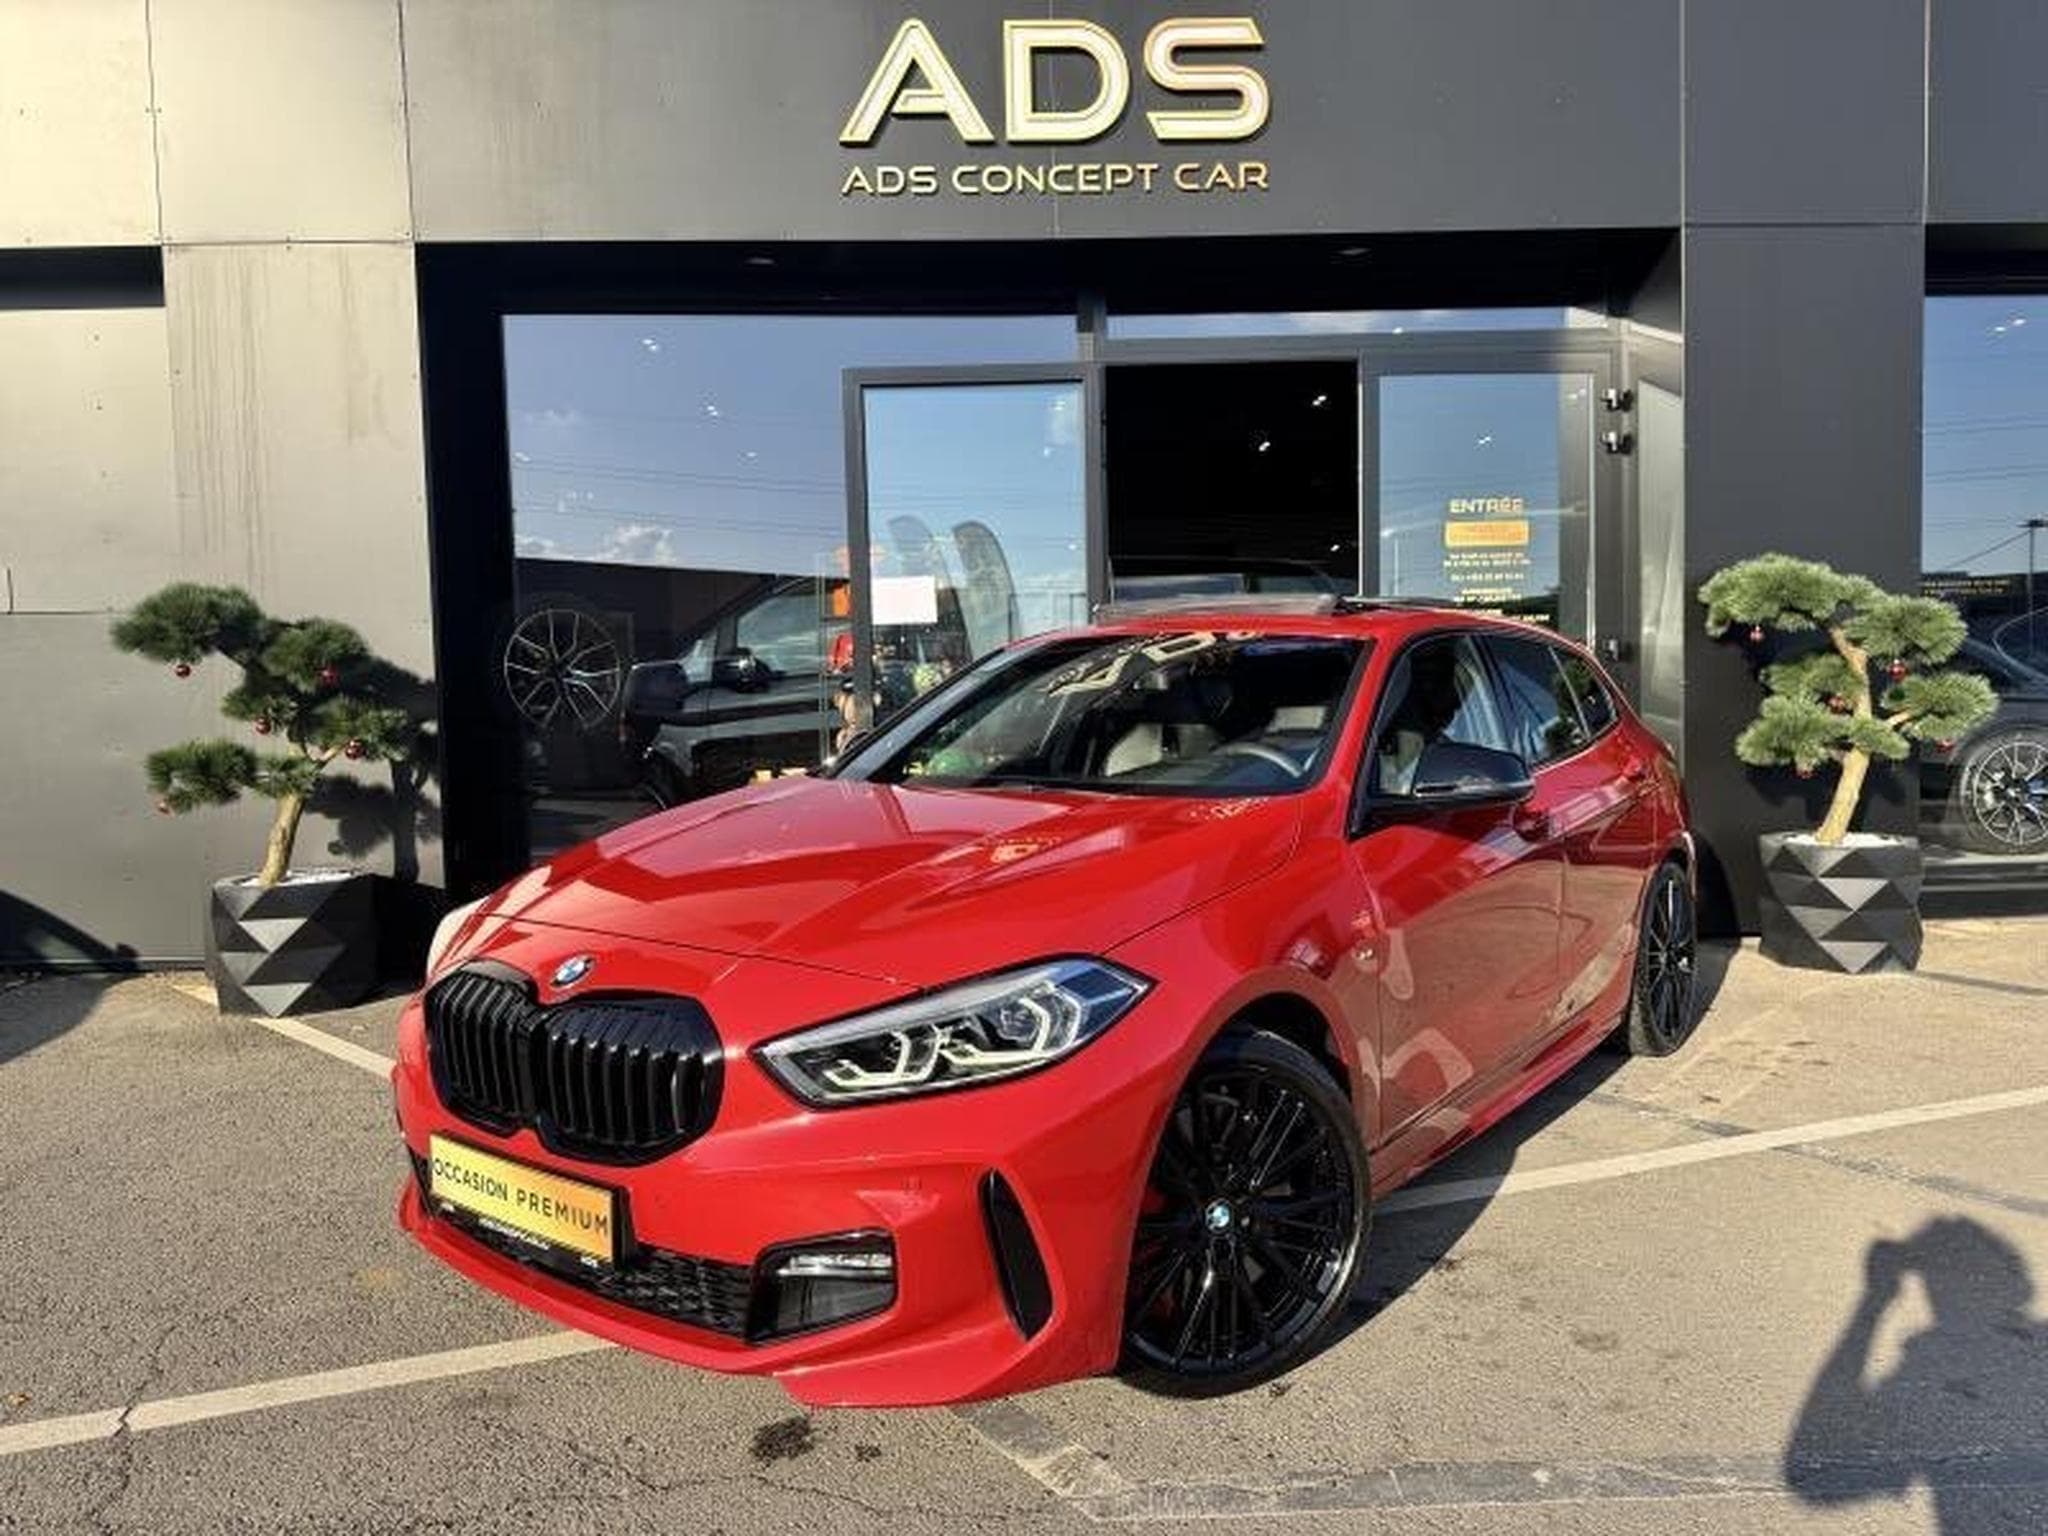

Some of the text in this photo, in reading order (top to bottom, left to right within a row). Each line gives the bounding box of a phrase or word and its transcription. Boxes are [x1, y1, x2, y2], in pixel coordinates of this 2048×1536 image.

[839, 17, 1270, 143] ADS
[842, 162, 1270, 194] ADS CONCEPT CAR
[433, 1158, 508, 1201] OCCASION
[516, 1189, 609, 1236] PREMIUM
